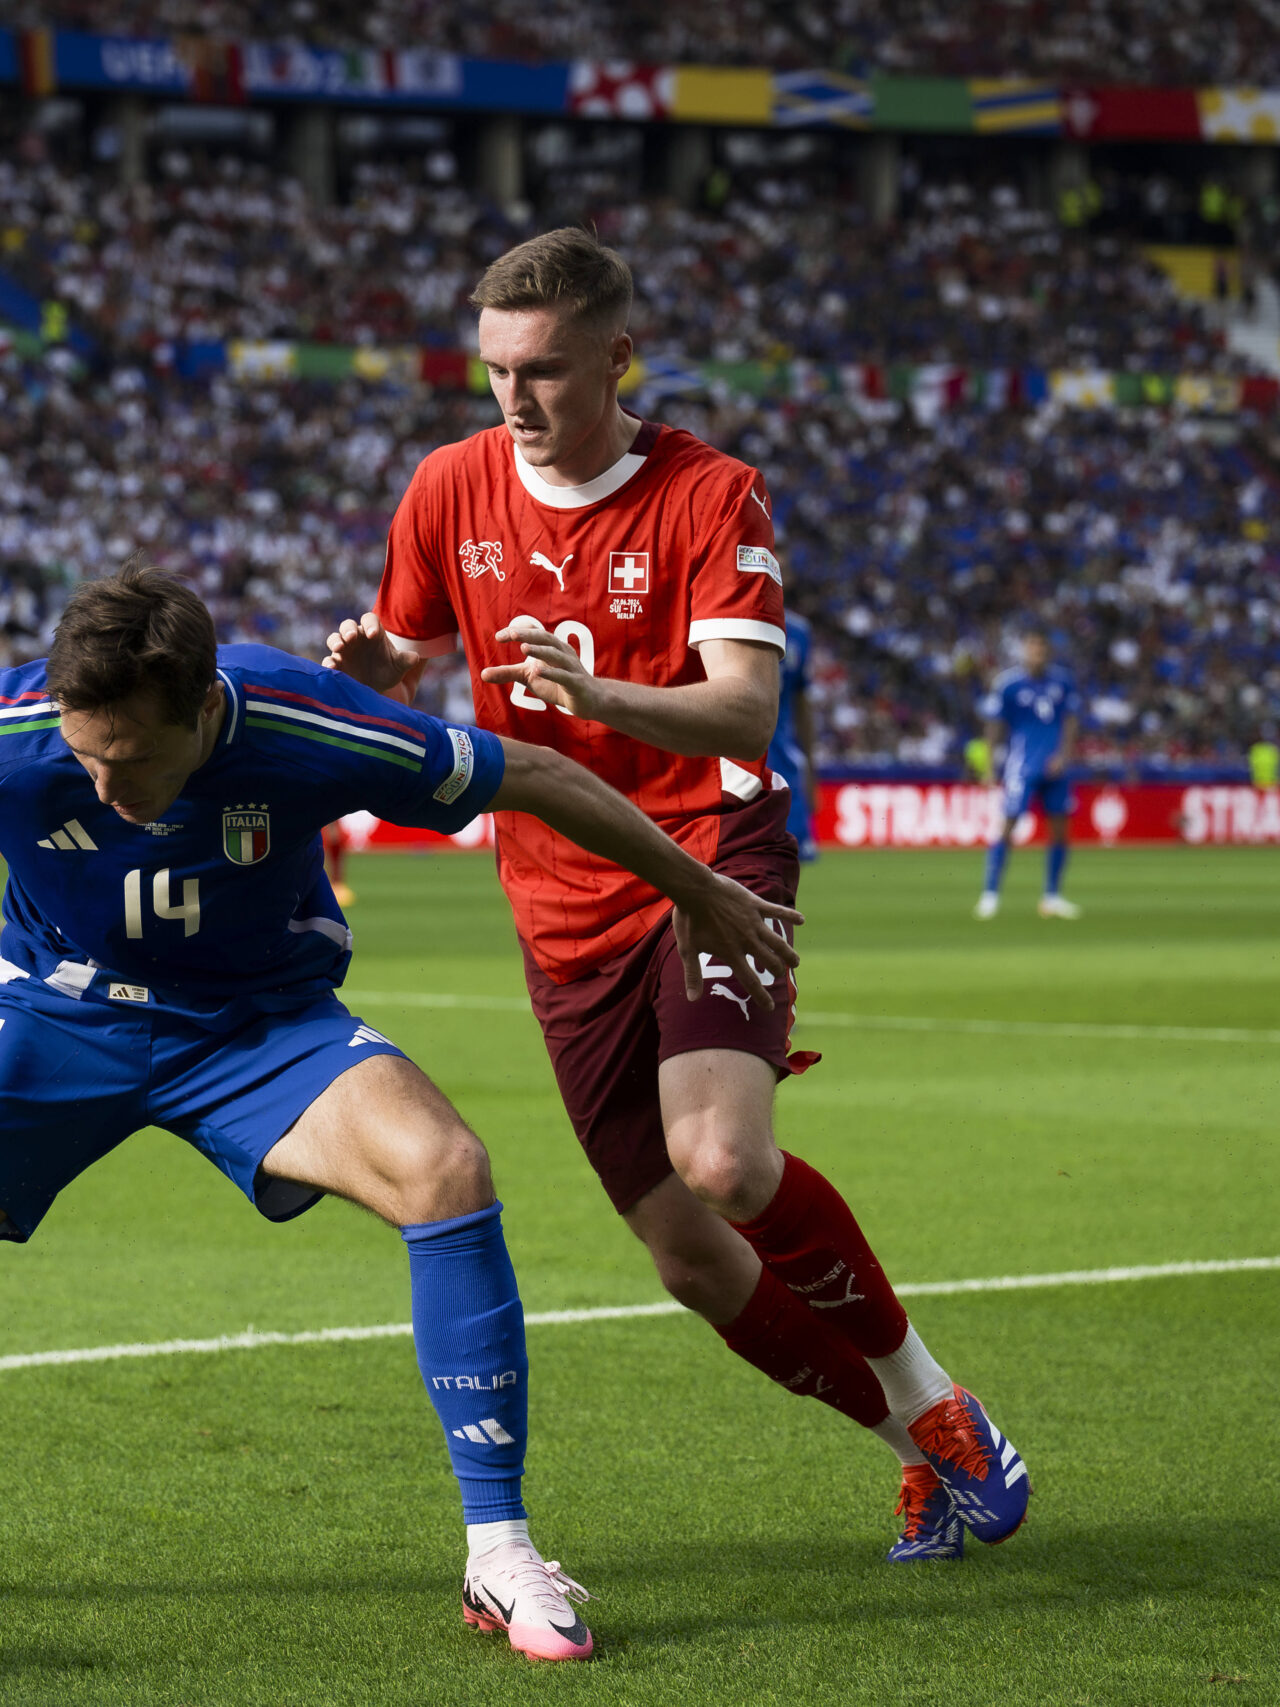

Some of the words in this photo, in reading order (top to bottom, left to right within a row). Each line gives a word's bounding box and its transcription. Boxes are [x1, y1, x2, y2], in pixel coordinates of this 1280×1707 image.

[609, 604, 622, 613] SUI
[630, 604, 643, 613] ITA
[439, 731, 468, 800] FOUNDATION
[226, 816, 265, 827] ITALIA
[124, 867, 201, 939] 14
[432, 1371, 517, 1390] ITALIA
